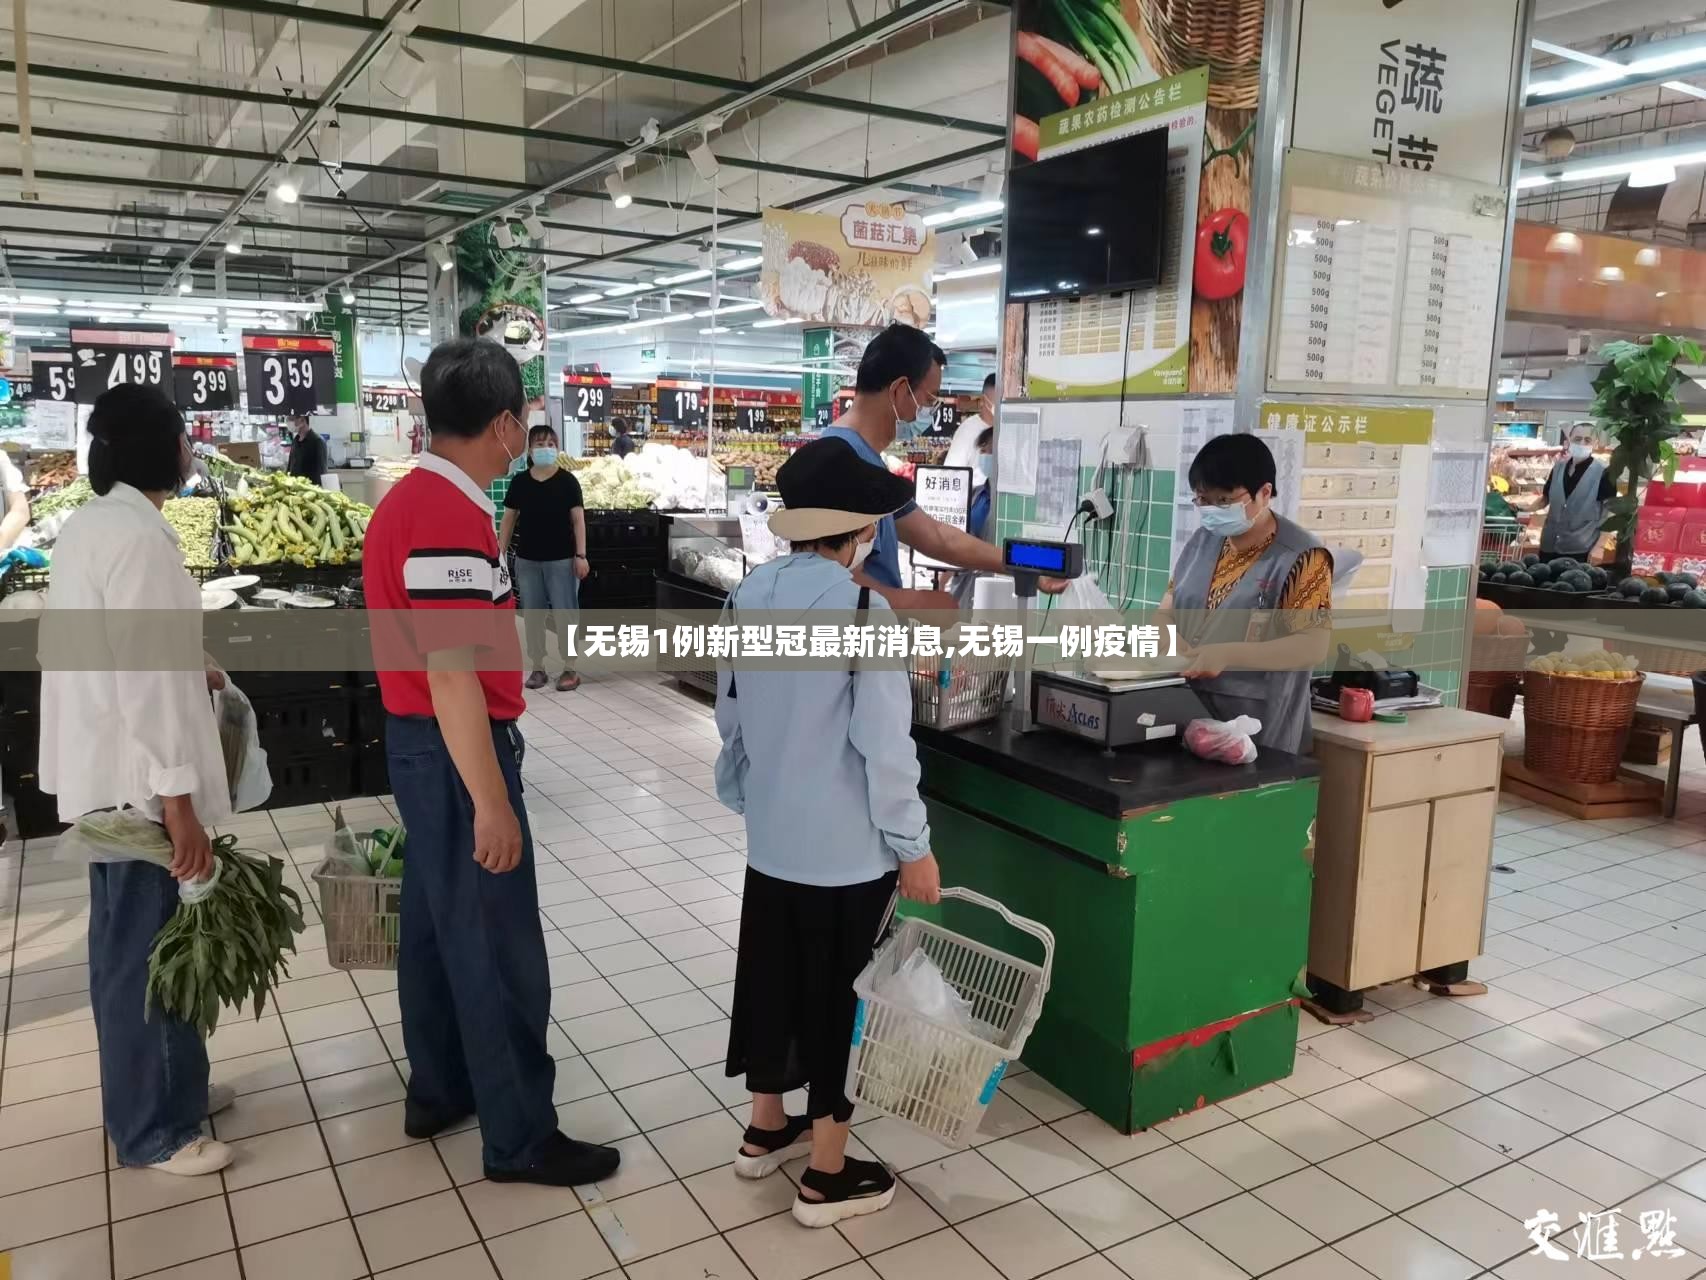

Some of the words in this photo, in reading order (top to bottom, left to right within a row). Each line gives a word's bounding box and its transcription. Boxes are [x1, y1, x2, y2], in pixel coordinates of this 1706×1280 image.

[1372, 39, 1400, 164] VEGET
[1058, 83, 1182, 136] 蔬果农药检测公告栏
[1317, 220, 1335, 231] 500g
[853, 220, 918, 246] 菌菇汇集
[1316, 237, 1334, 248] 500g
[1314, 254, 1332, 265] 500g
[1313, 271, 1331, 281] 500g
[1312, 288, 1329, 298] 500g
[1311, 304, 1328, 314] 500g
[1310, 320, 1327, 331] 500g
[1308, 337, 1326, 347] 500g
[1307, 353, 1324, 363] 500g
[1305, 369, 1323, 379] 500g
[193, 370, 227, 404] 399
[263, 357, 313, 405] 359
[577, 387, 603, 417] 299
[675, 391, 698, 419] 179
[747, 408, 765, 433] 199
[1266, 412, 1369, 434] 健康证公示栏
[925, 476, 961, 491] 好消息
